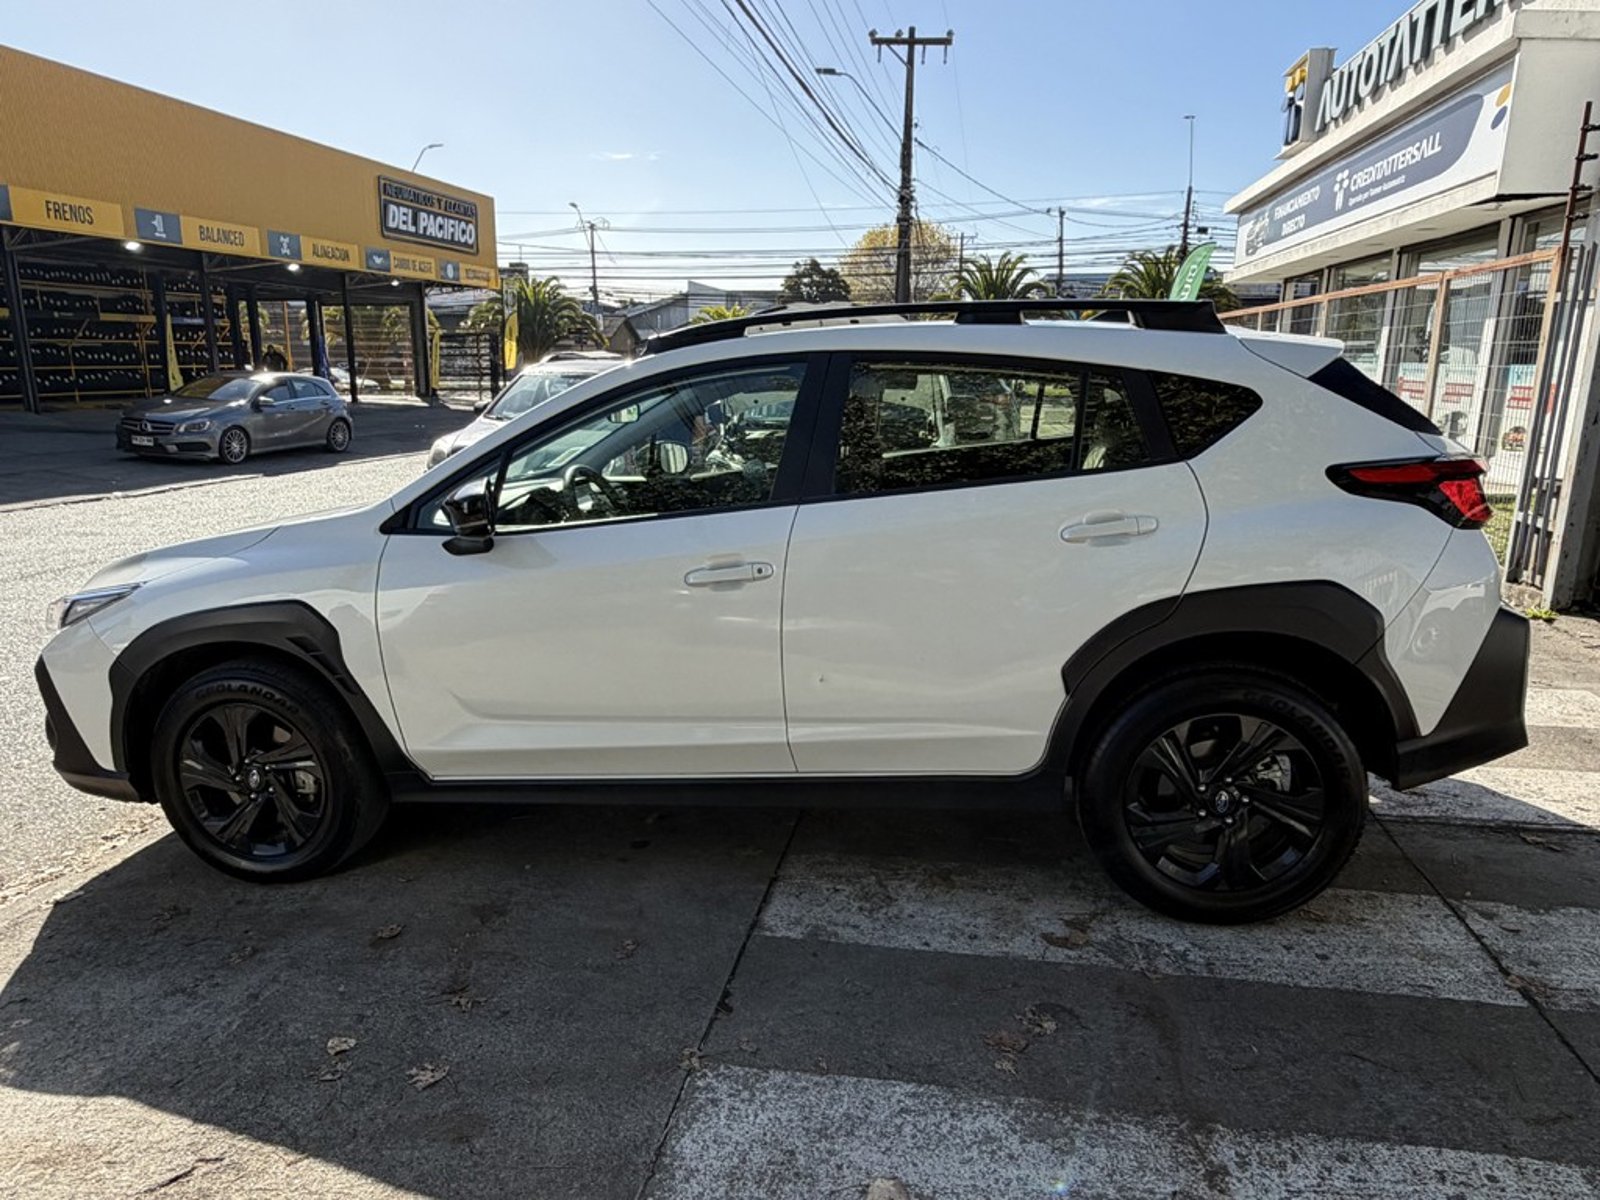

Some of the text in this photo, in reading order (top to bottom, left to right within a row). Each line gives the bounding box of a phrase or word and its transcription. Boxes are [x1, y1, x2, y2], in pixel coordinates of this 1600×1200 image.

[1314, 0, 1502, 133] AUTOTATTE
[1349, 132, 1442, 192] CREDITATTERSALL
[45, 200, 94, 225] FRENOS
[387, 204, 476, 245] DEL PACIFICO
[199, 225, 245, 247] BALANCEO
